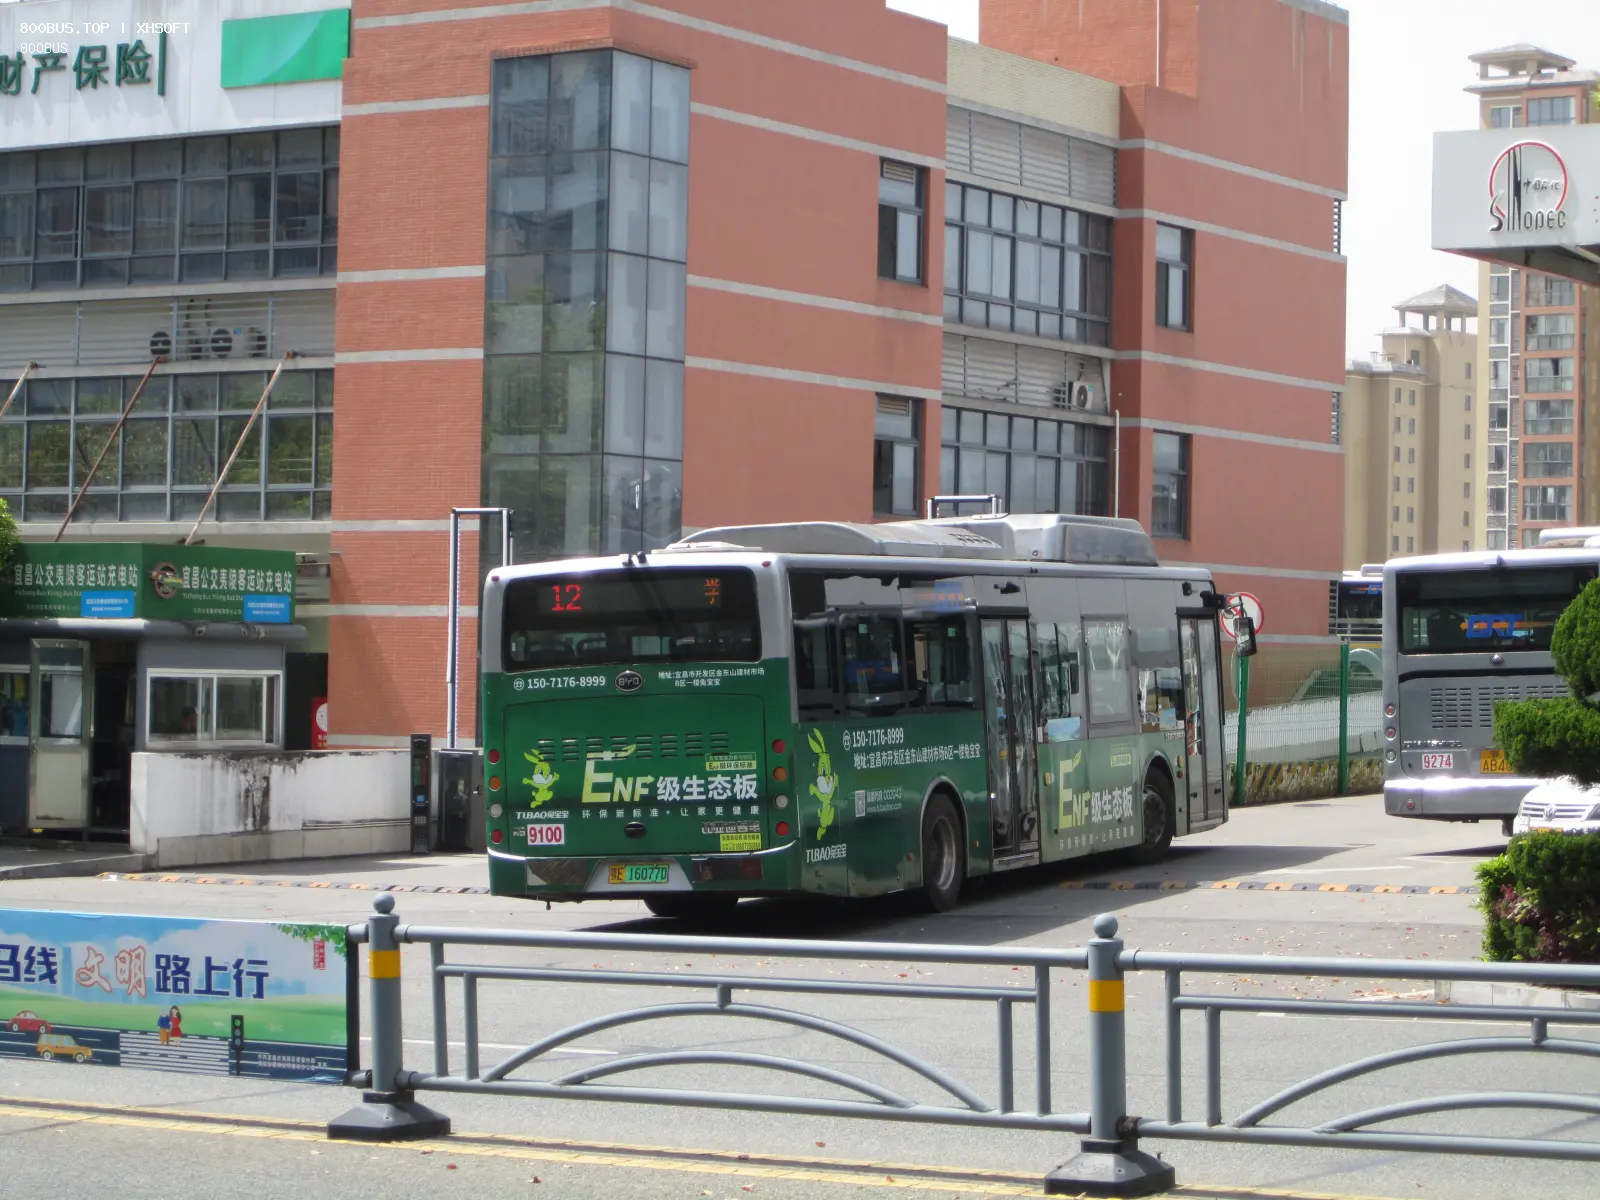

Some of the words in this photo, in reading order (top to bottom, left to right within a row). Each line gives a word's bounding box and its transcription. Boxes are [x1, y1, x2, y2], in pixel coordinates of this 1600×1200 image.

[14, 563, 138, 587] 宜昌公交夷陵客运站充电站
[182, 565, 292, 593] 宜昌公交夷陵客运站充电站
[551, 584, 582, 611] 12
[527, 675, 606, 689] 150-7176-8999
[852, 727, 904, 748] 150-7176-8999
[1424, 754, 1452, 769] 9274
[529, 826, 563, 844] 9100
